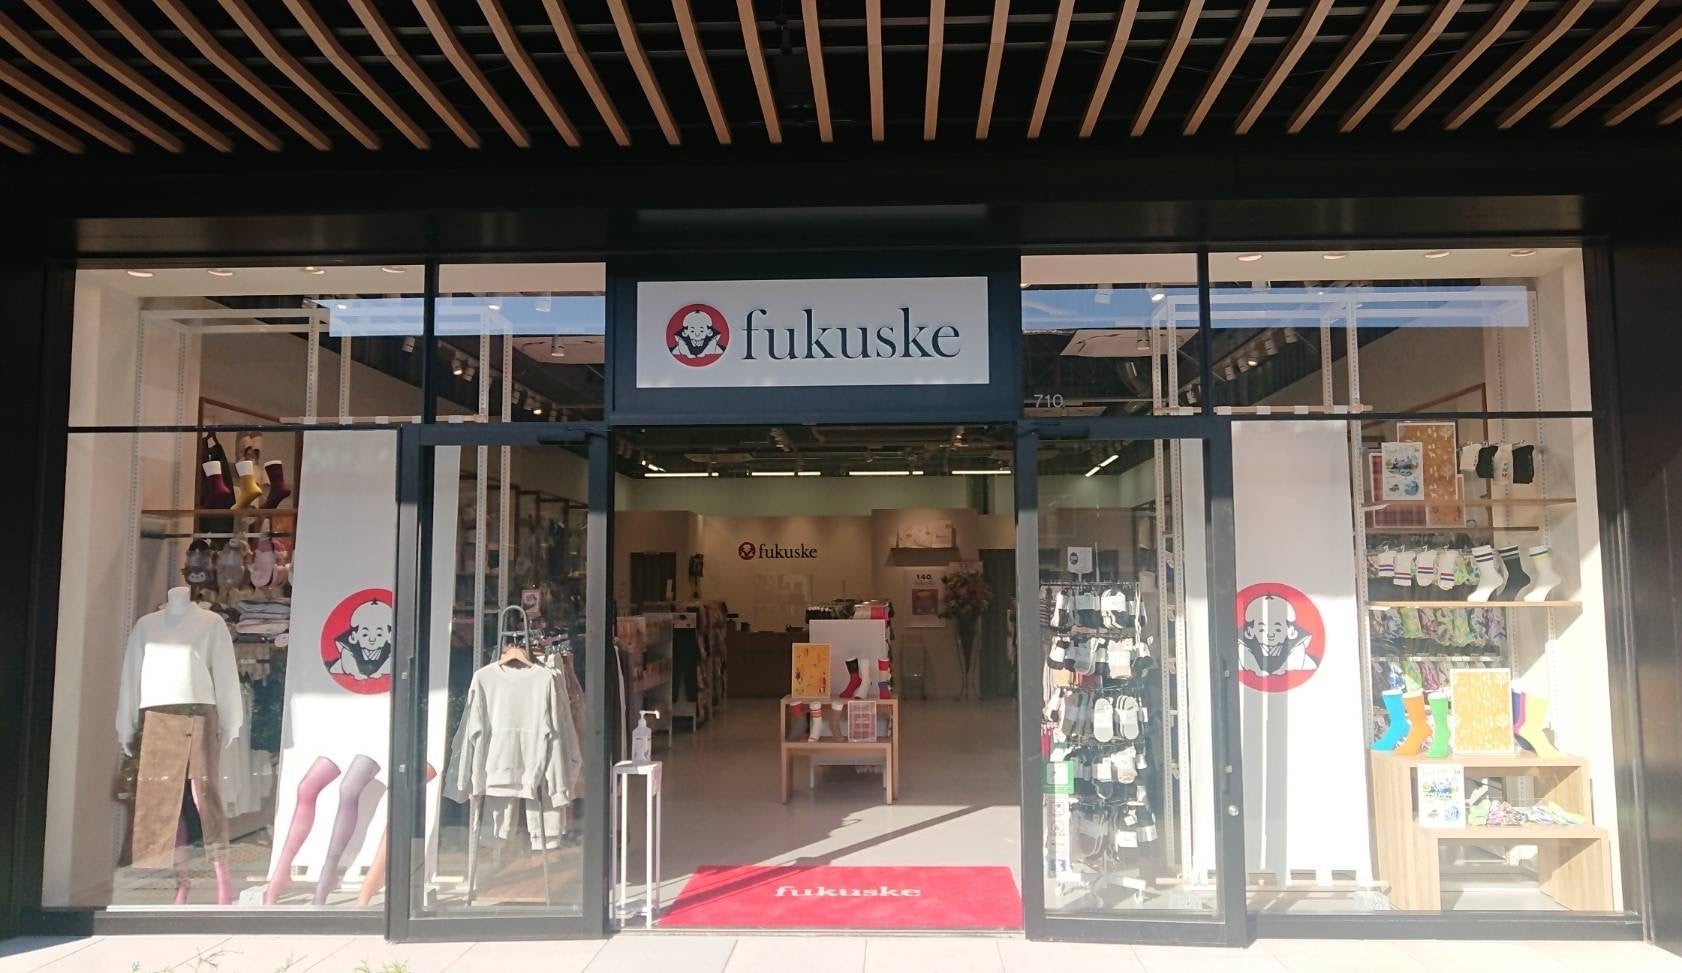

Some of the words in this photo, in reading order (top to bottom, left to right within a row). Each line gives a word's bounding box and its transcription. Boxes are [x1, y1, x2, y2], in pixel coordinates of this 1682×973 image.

[741, 307, 961, 360] fukuske
[1033, 394, 1064, 408] 710
[759, 543, 818, 559] fukuske
[774, 884, 922, 898] fukuske
